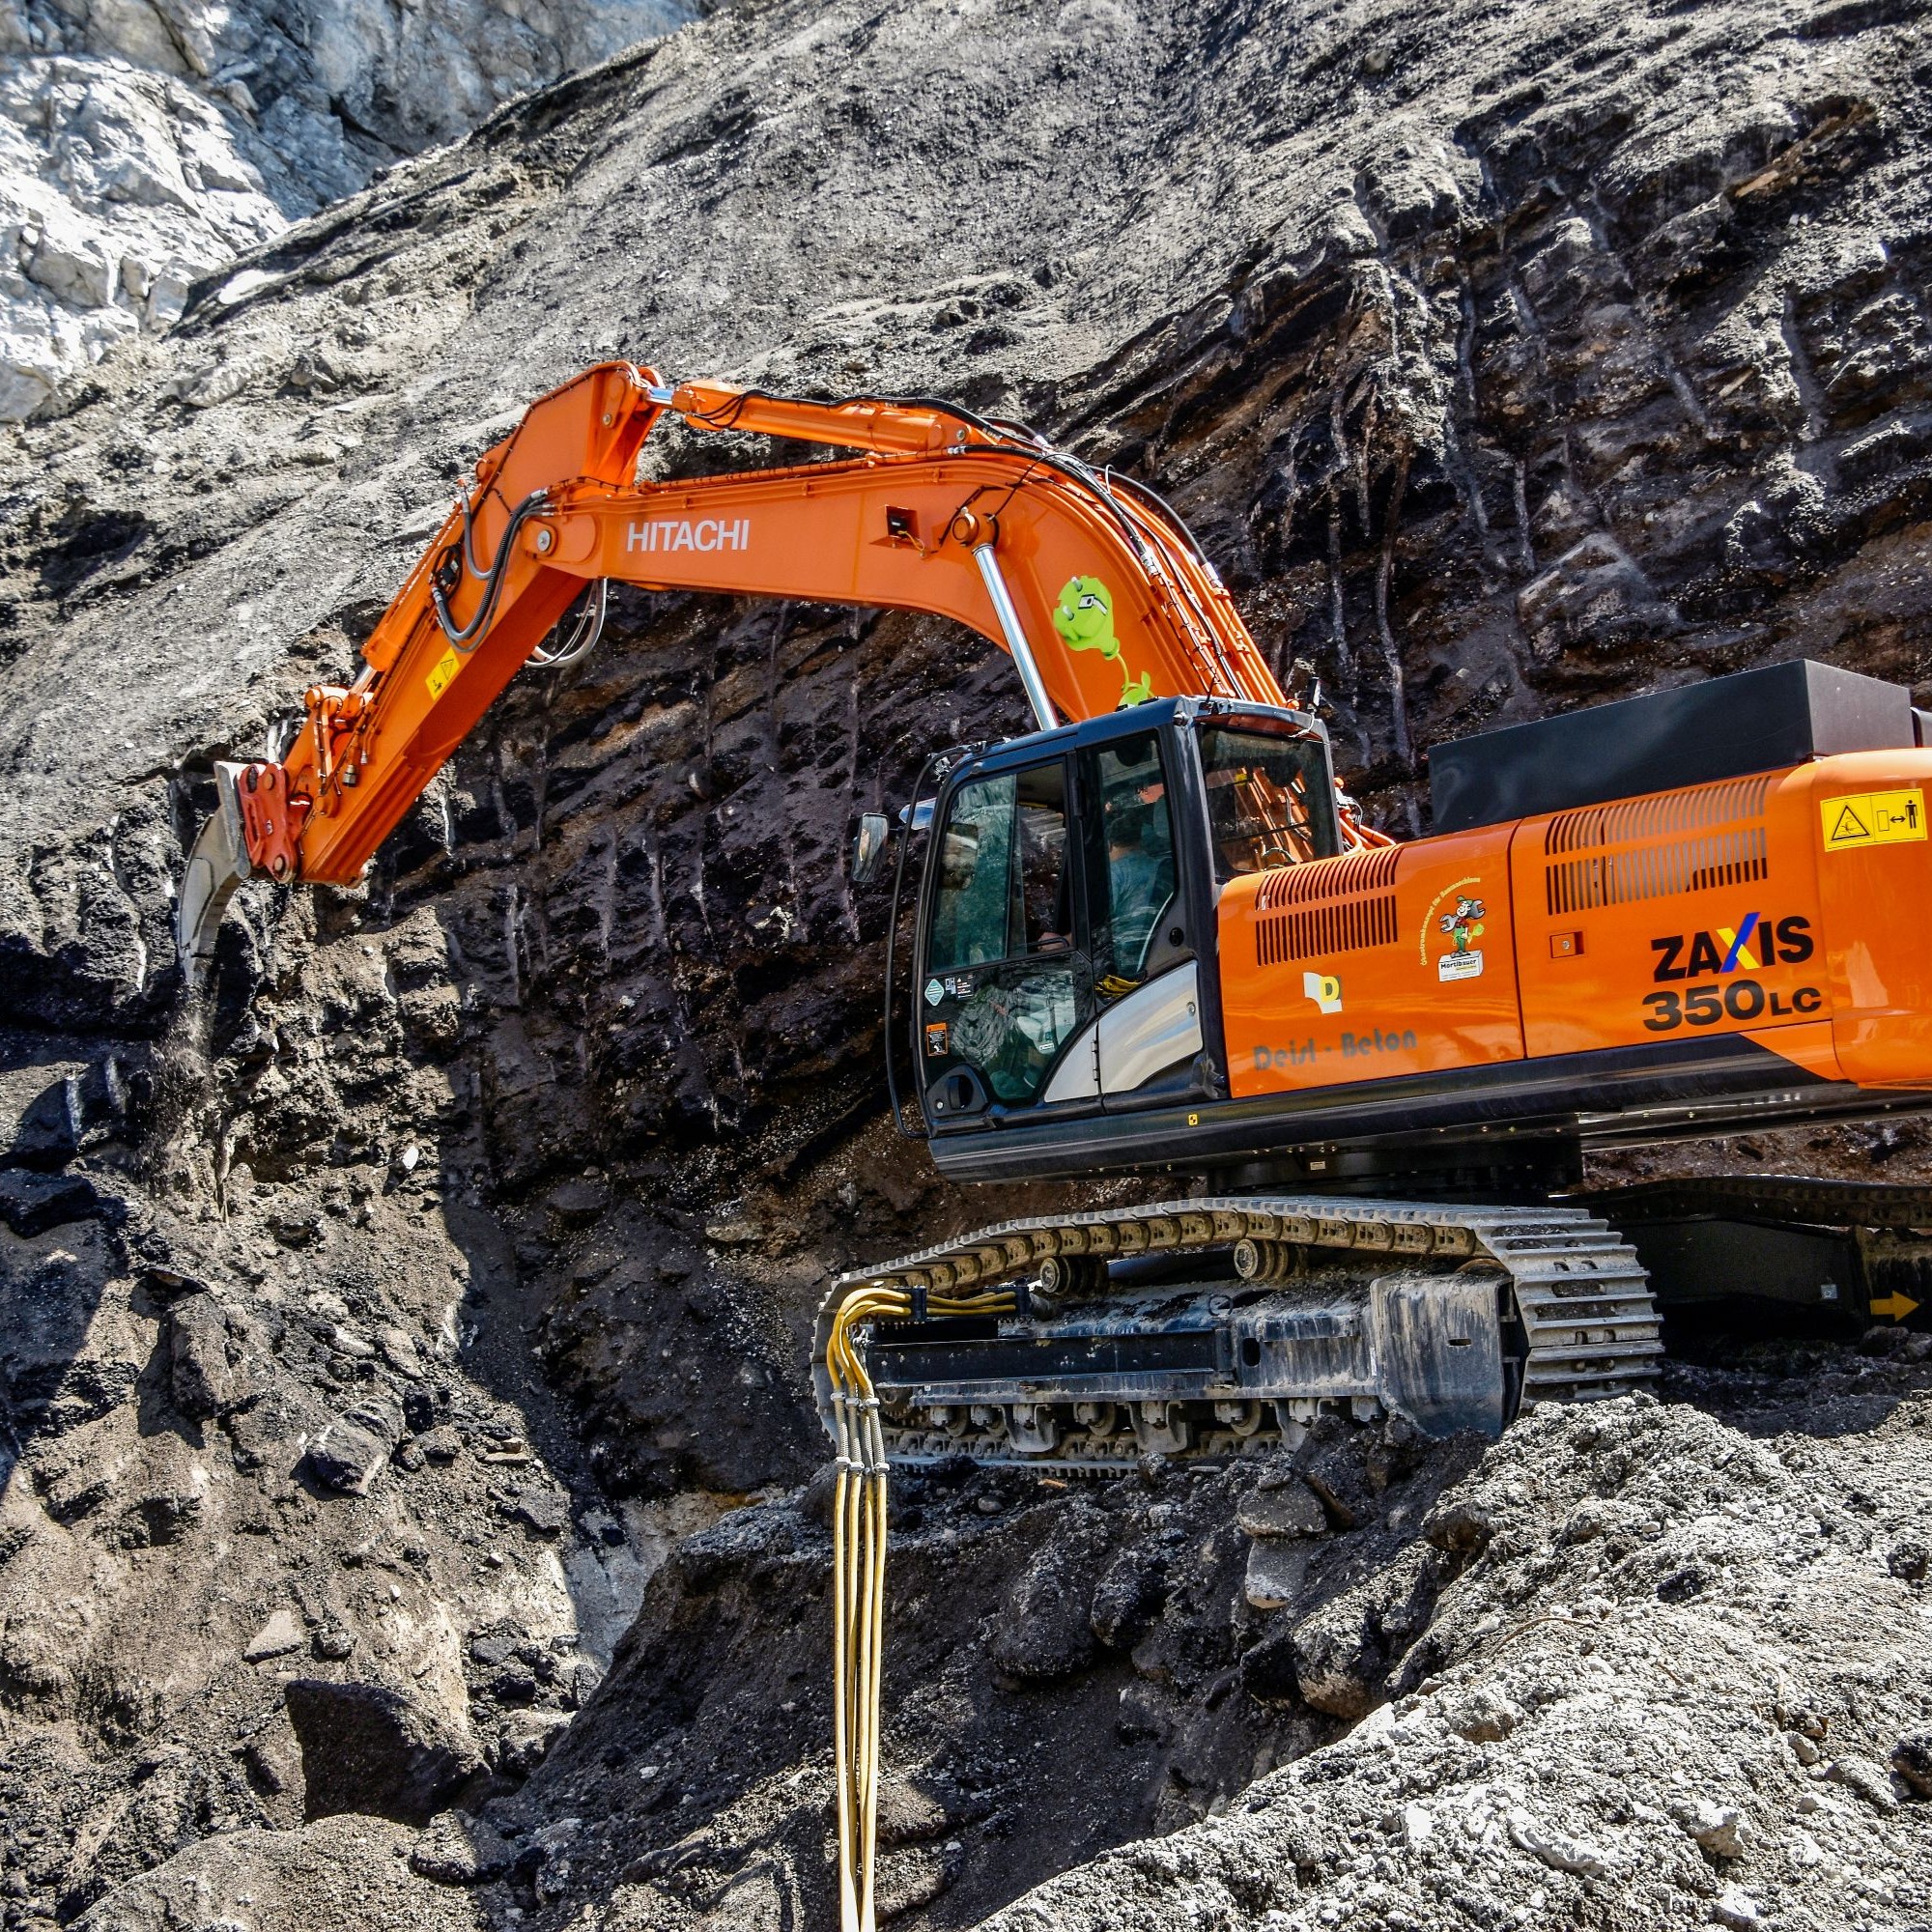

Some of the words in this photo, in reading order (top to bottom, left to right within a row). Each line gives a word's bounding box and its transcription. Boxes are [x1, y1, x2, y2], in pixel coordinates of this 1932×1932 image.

[627, 519, 750, 552] HITACHI
[1650, 912, 1814, 983] ZAXIS
[1253, 1037, 1316, 1071] Deisl
[1341, 1028, 1417, 1059] Beton
